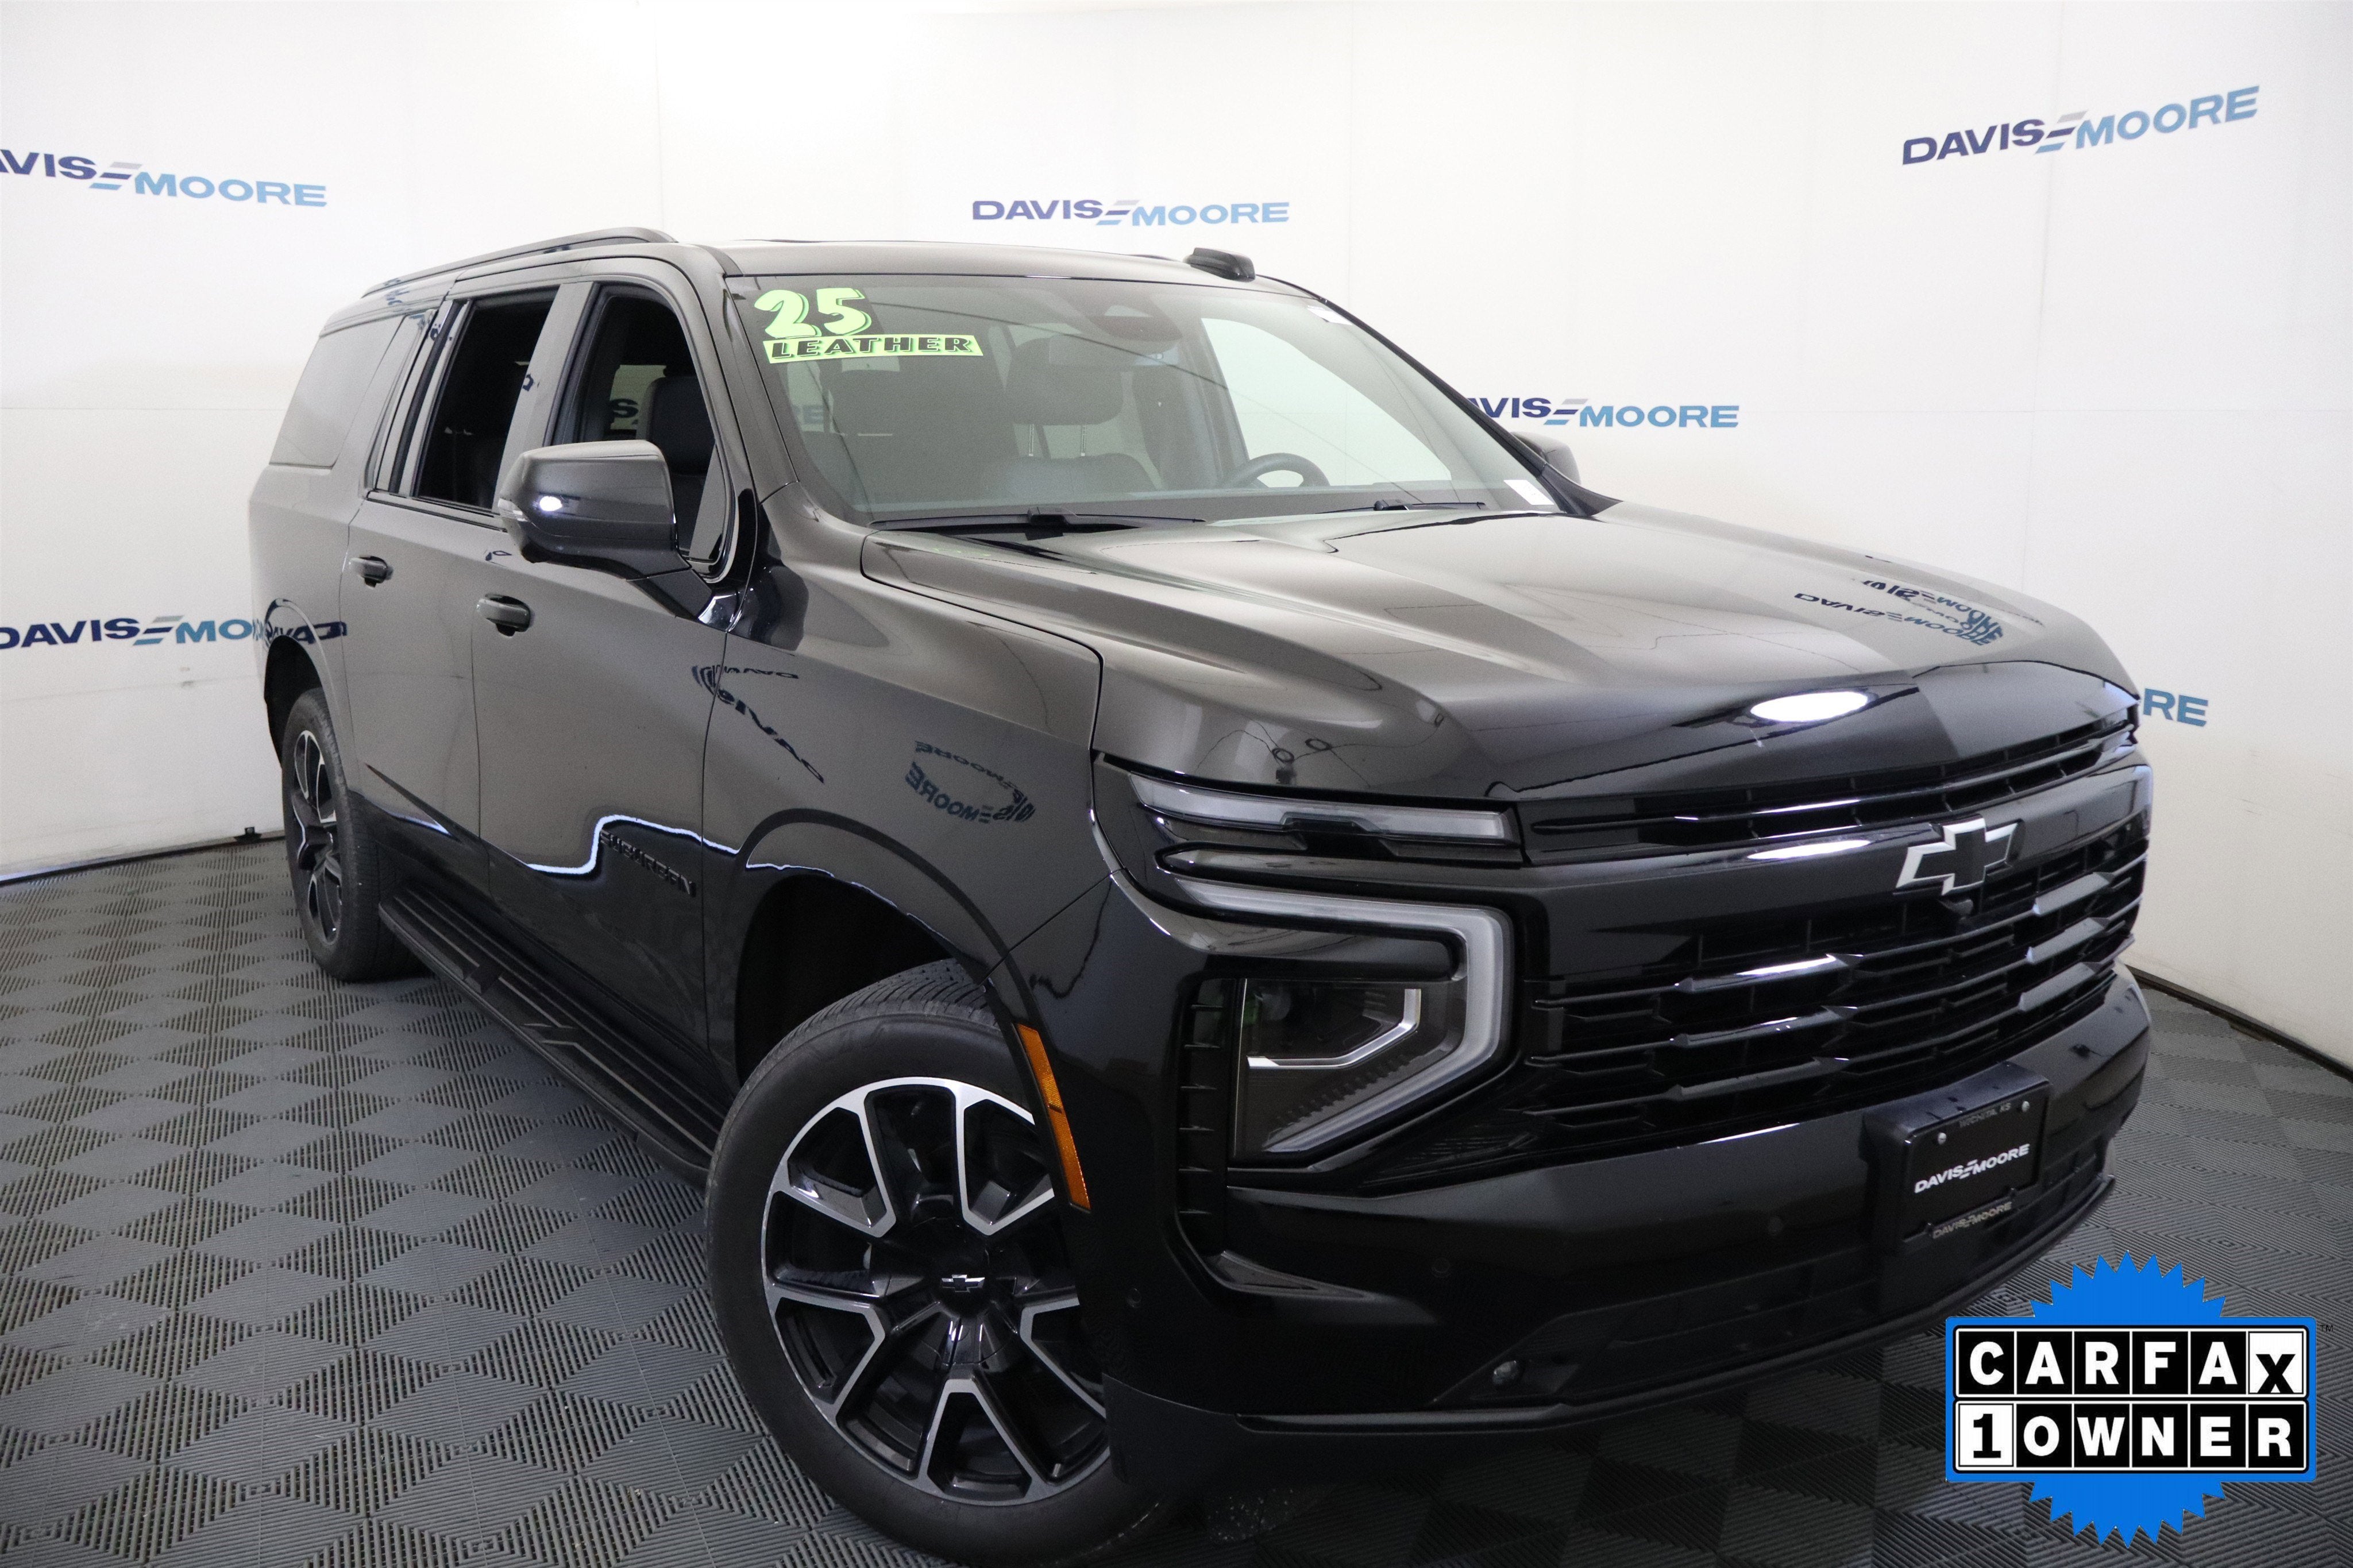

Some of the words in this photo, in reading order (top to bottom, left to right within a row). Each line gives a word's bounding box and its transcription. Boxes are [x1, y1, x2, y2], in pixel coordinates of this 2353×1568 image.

[1902, 118, 2045, 165] DAVIS
[2076, 85, 2260, 149] MOORE
[135, 172, 327, 207] MOORE
[973, 199, 1103, 220] DAVIS
[1132, 202, 1290, 226] MOORE
[754, 288, 872, 338] 25
[772, 336, 973, 358] LEATHER
[1467, 397, 1552, 418] VIS
[1579, 405, 1739, 428] MOORE
[0, 619, 140, 649] DAVIS
[176, 619, 253, 644] MO
[2143, 688, 2208, 727] RE
[1915, 1165, 1964, 1194] DAVIS
[1973, 1144, 2030, 1175] MOORE
